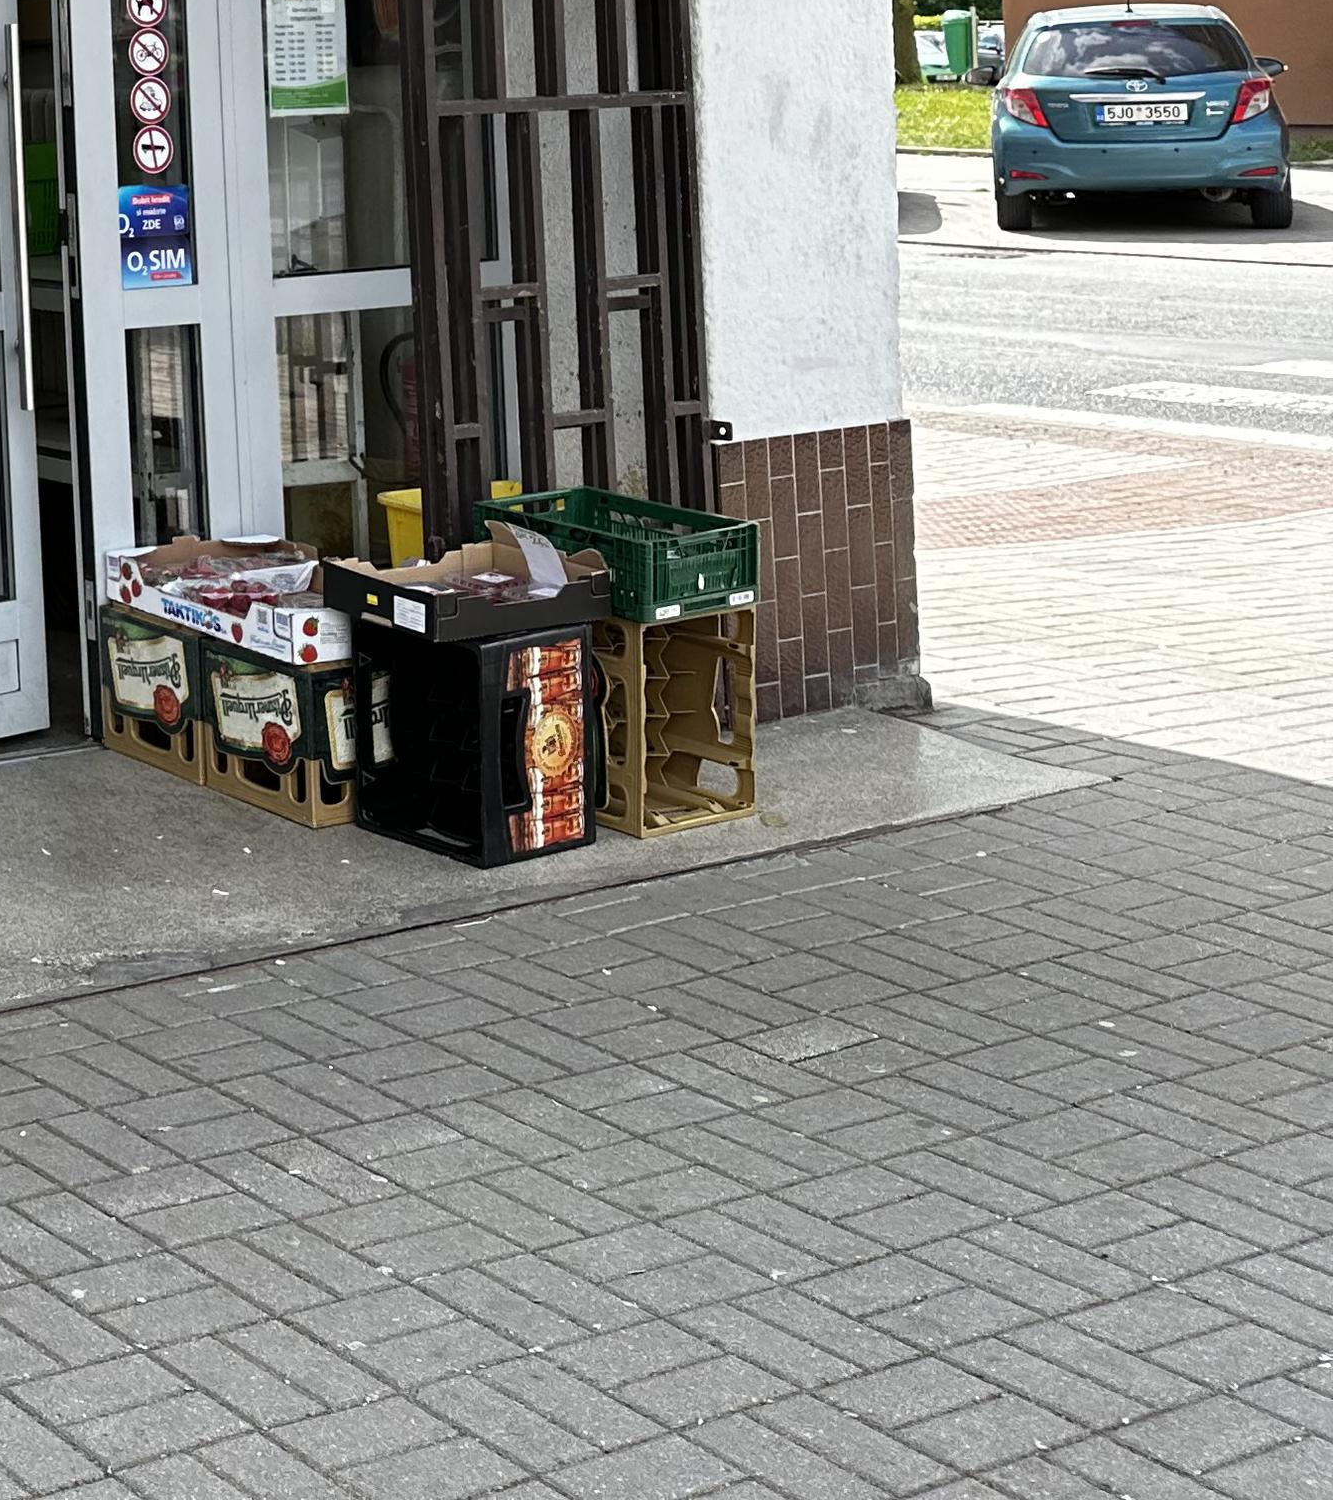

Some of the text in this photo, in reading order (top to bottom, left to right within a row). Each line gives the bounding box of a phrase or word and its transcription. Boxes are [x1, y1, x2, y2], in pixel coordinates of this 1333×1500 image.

[1145, 106, 1181, 119] 3550
[142, 218, 162, 230] ZDE
[149, 248, 186, 271] SIM
[221, 689, 293, 726] Pilsner Urquell
